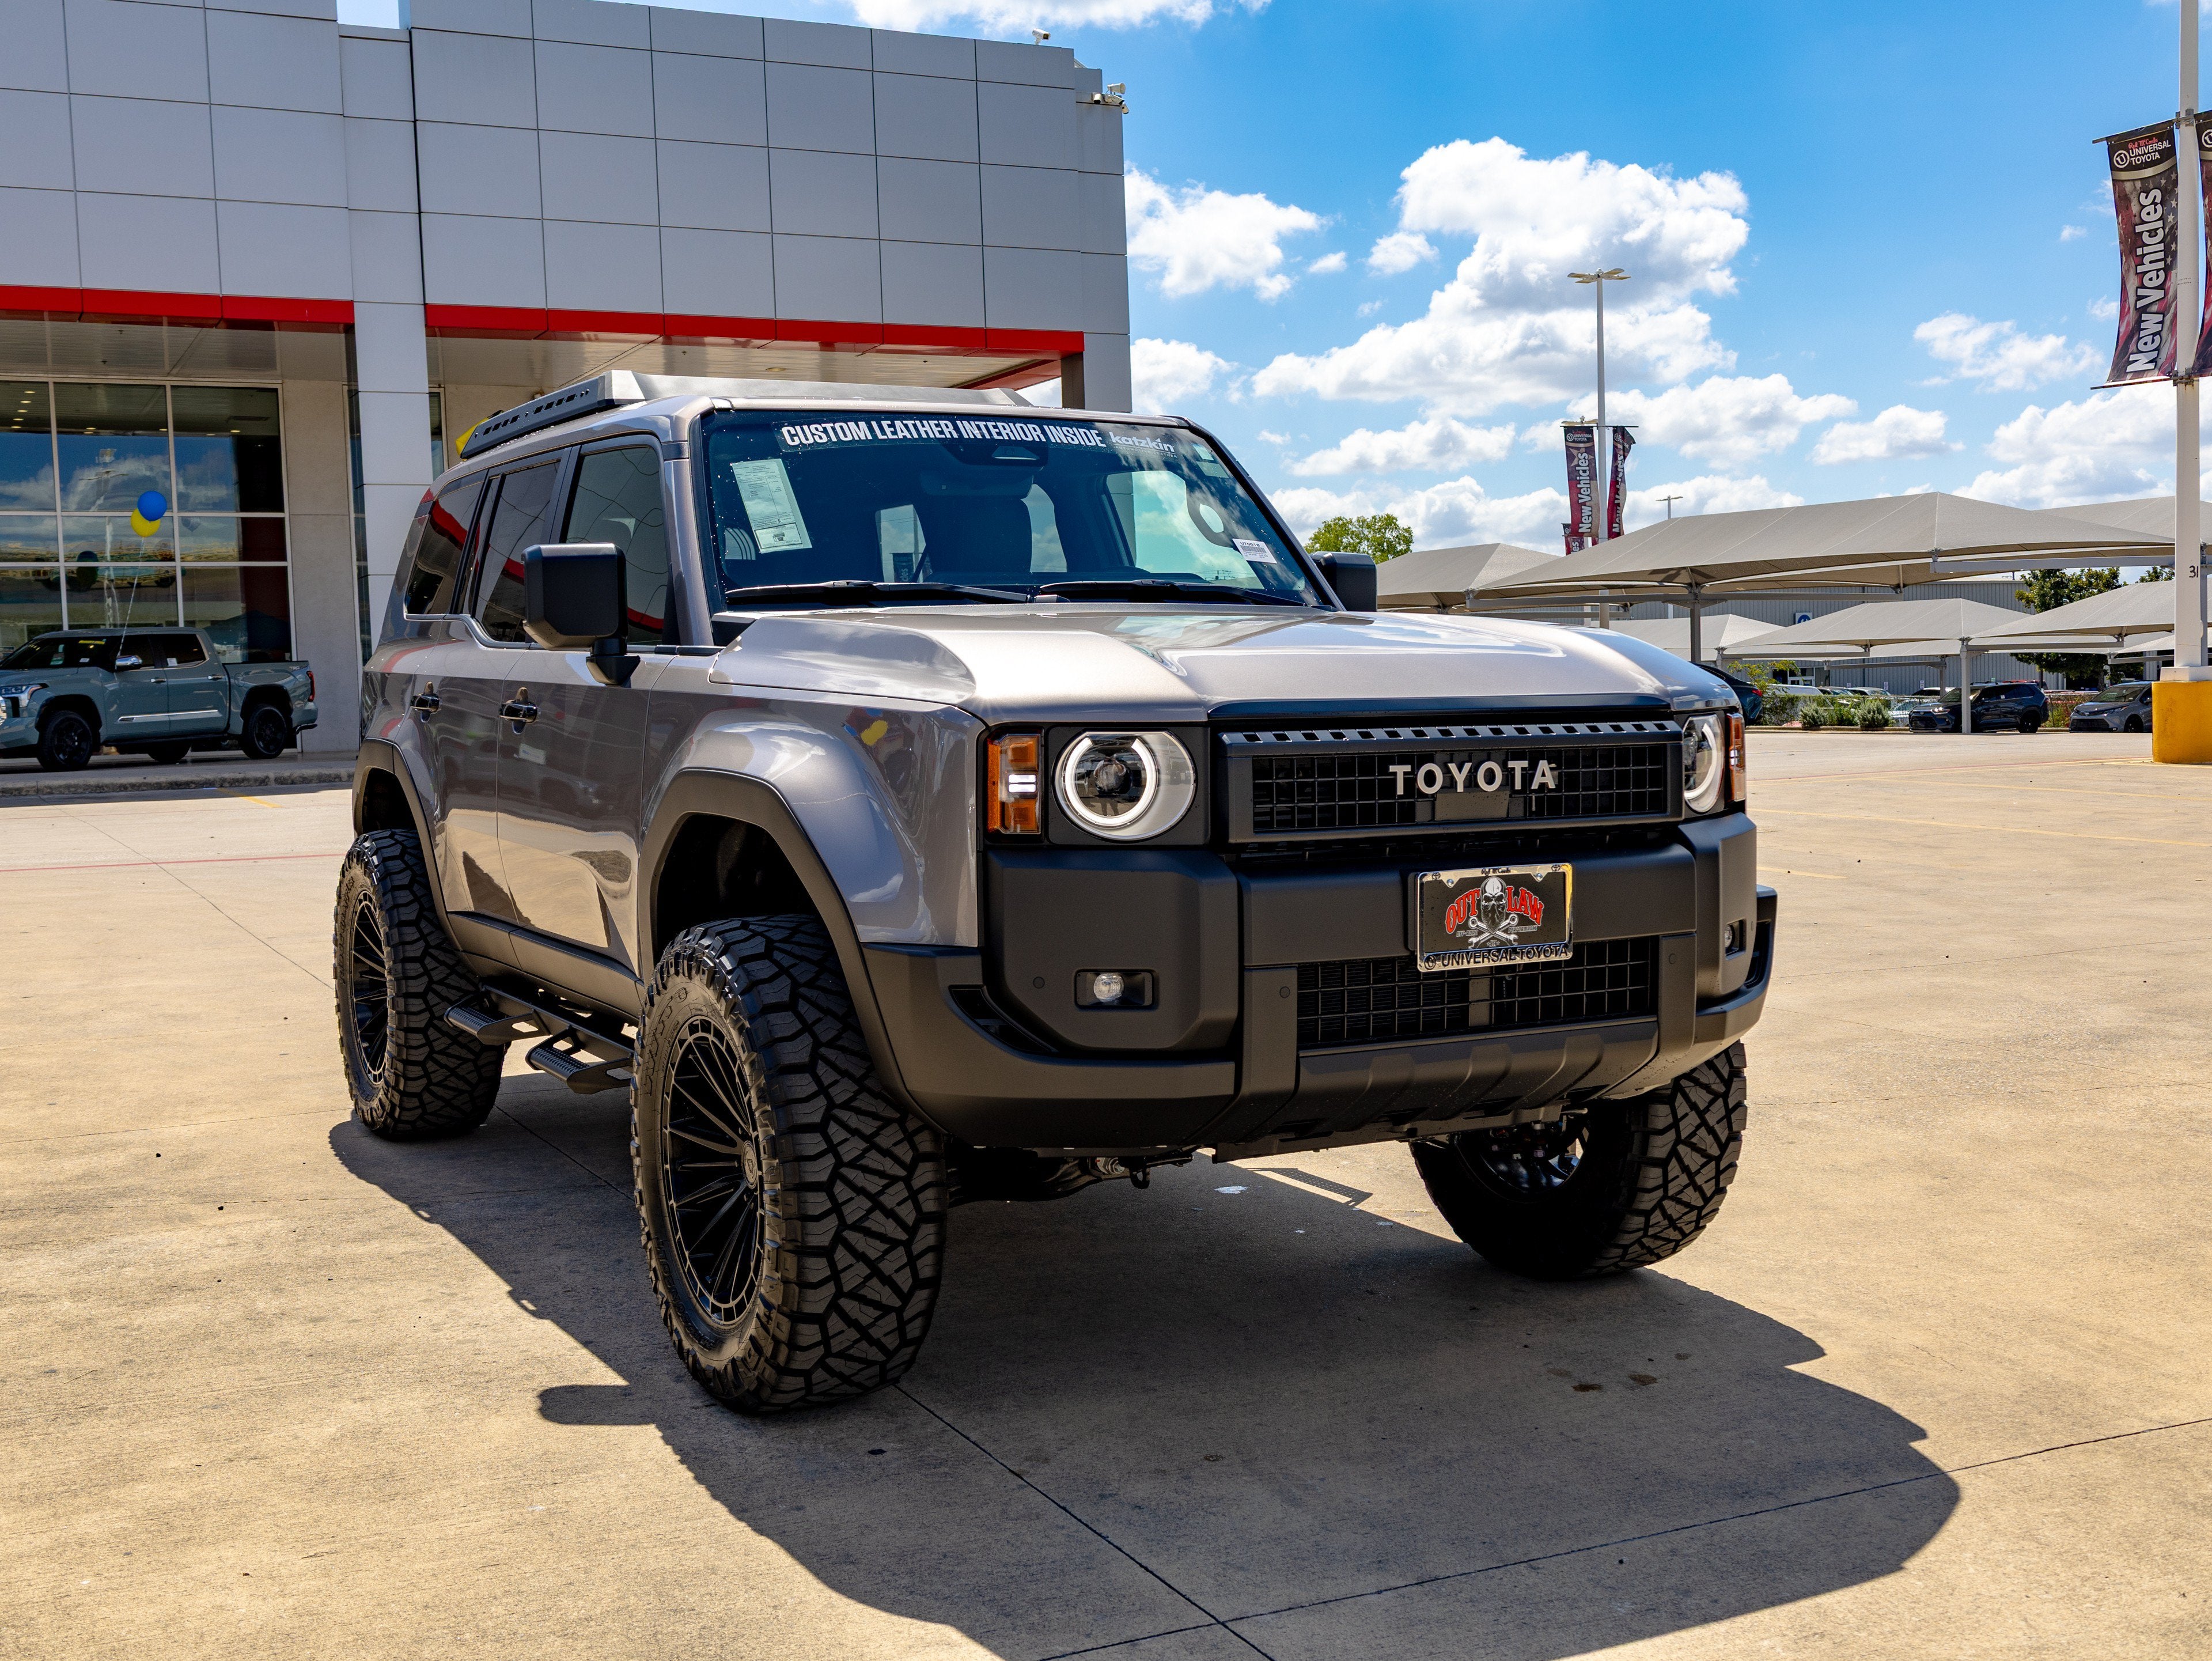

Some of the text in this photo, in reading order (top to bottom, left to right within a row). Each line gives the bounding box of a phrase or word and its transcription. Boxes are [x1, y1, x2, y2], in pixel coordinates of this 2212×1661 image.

[2130, 140, 2171, 157] UNIVERSAL
[2131, 152, 2160, 165] TOYOTA
[2126, 188, 2165, 372] New Vehicles
[782, 420, 1106, 447] CUSTOM LEATHER INTERIOR INSIDE
[1109, 432, 1175, 453] katzkin
[1575, 452, 1592, 503] Vehicles
[1578, 505, 1592, 532] New
[2189, 565, 2199, 578] 31
[1389, 760, 1556, 795] TOYOTA
[1441, 944, 1568, 967] UNIVERSAL TOYOTA
